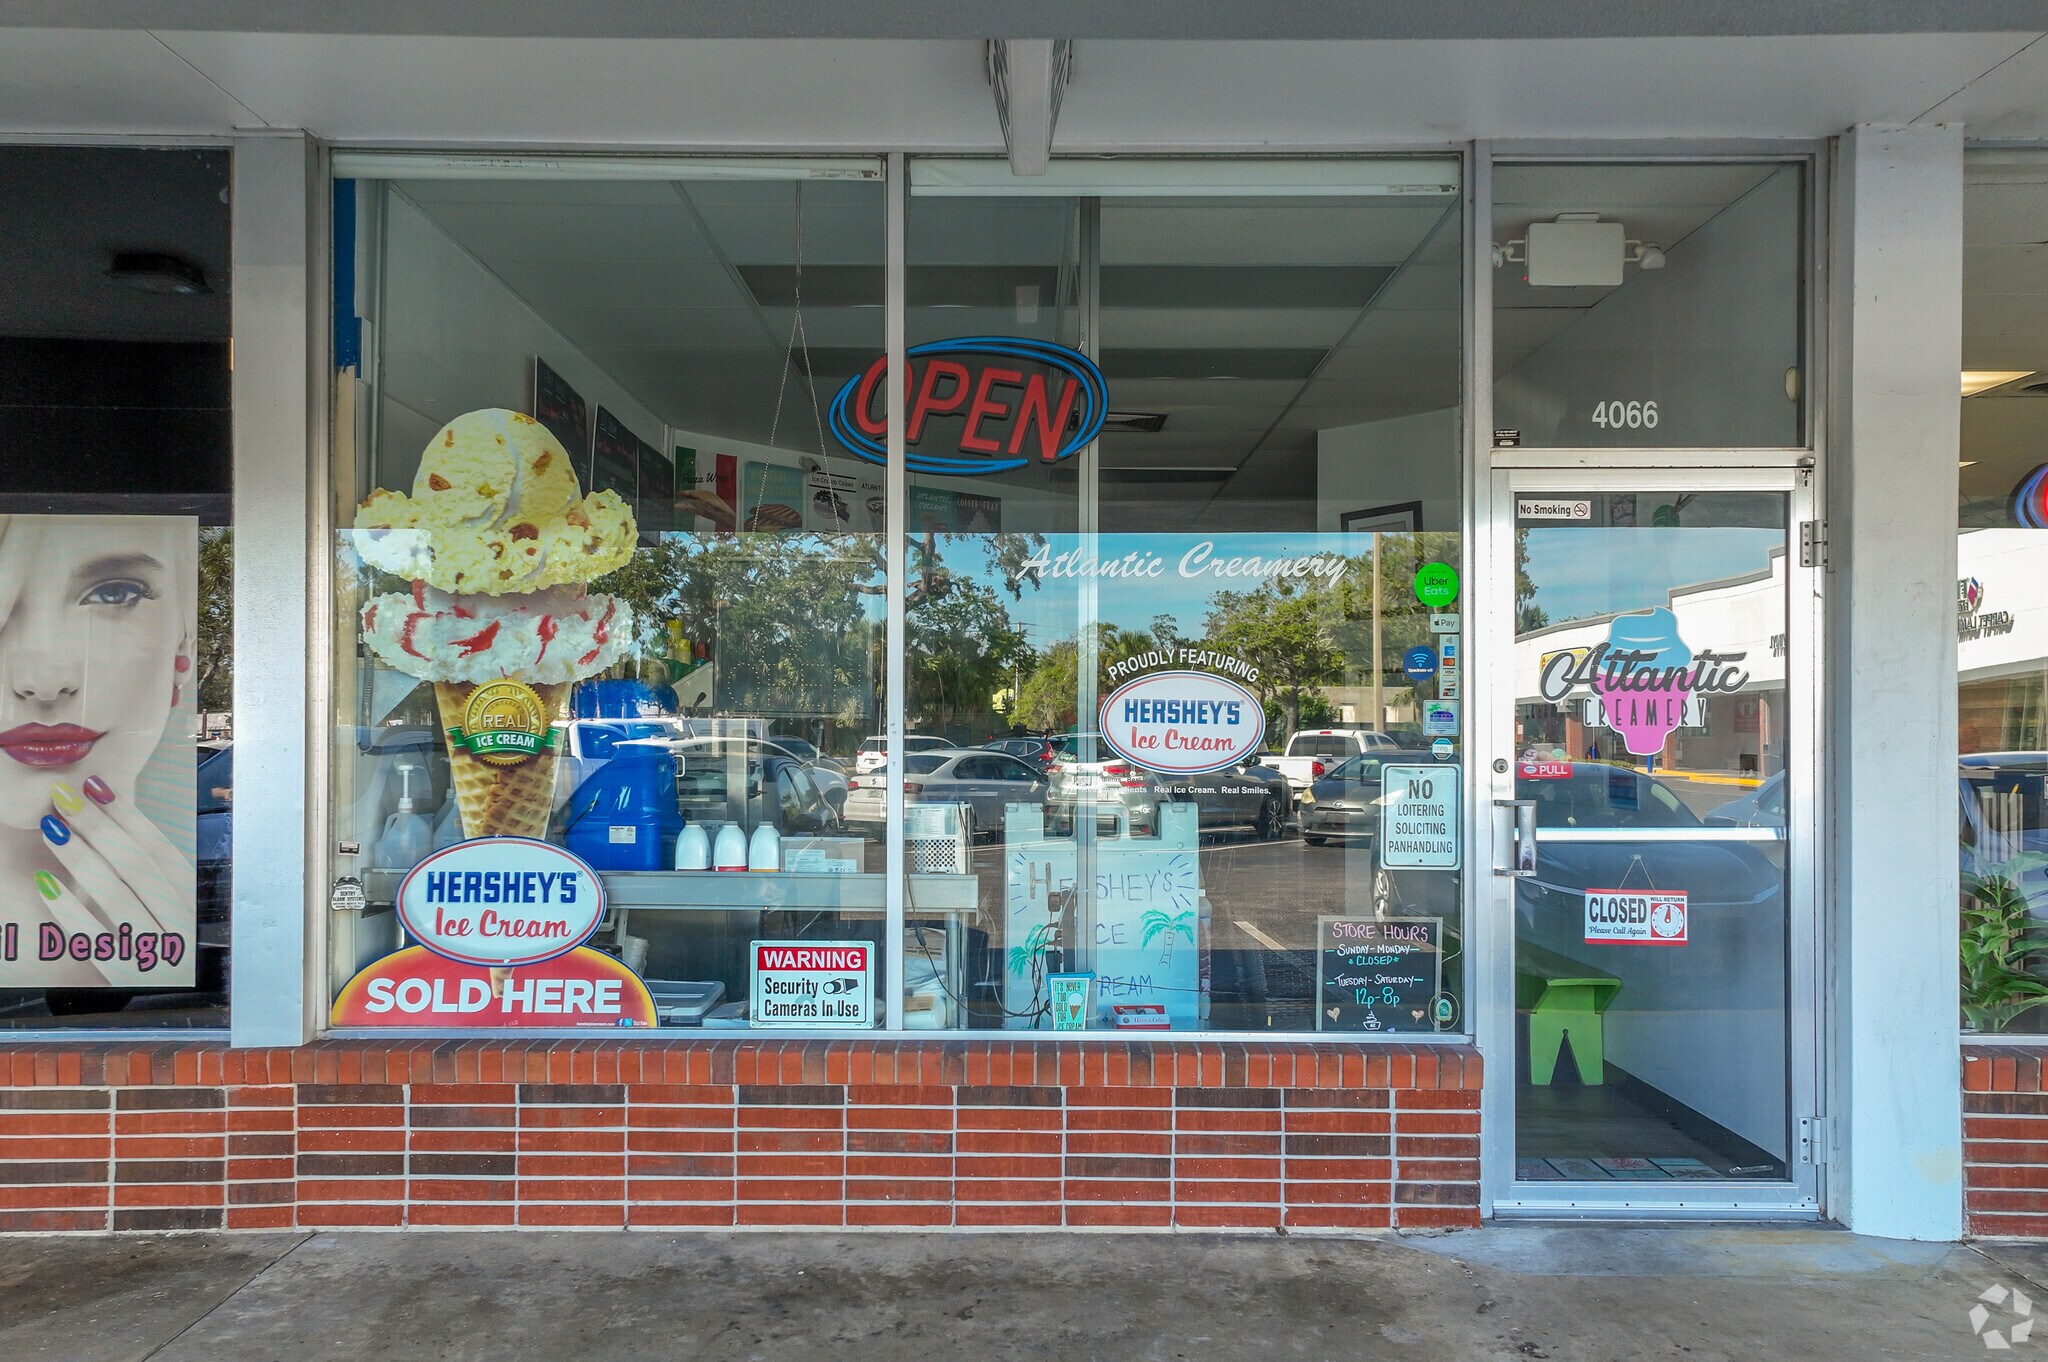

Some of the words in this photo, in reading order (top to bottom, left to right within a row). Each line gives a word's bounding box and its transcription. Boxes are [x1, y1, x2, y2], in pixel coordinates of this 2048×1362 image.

[855, 353, 1079, 460] OPEN
[1592, 400, 1659, 429] 4066
[811, 475, 820, 483] Ice
[838, 479, 855, 489] Cakes
[916, 493, 950, 504] ATLANTIC
[918, 502, 949, 512] CYCLONE
[957, 497, 978, 509] COFFEE
[983, 501, 999, 512] FRAP
[1520, 504, 1532, 515] No
[1534, 504, 1571, 517] Smoking
[1015, 543, 1165, 580] Atlantic
[1177, 541, 1350, 590] Creamery
[1424, 576, 1449, 586] Uber
[1424, 586, 1449, 596] Eats
[1441, 619, 1456, 628] Pay
[1108, 648, 1176, 682] PROUDLY
[1179, 648, 1260, 683] FEATURING
[1540, 642, 1750, 701] Atlantic
[1124, 698, 1241, 726] HERSHEY'S
[1584, 698, 1707, 727] CREAMERY
[483, 714, 527, 729] REAL
[476, 736, 494, 749] ICE
[497, 733, 536, 749] CREAM
[1131, 725, 1161, 750] Ice
[1164, 728, 1237, 751] Cream
[1539, 765, 1569, 775] PULL
[1154, 786, 1172, 794] Real
[1174, 786, 1186, 794] Ice
[1188, 786, 1217, 794] Cream.
[1221, 786, 1239, 794] Real
[1241, 786, 1272, 795] Smiles.
[1408, 779, 1434, 800] NO
[1397, 803, 1445, 817] LOITERING
[1395, 822, 1446, 835] SOLICITING
[1388, 841, 1453, 854] PANHANDLING
[427, 870, 577, 904] HERSHEY'S
[1588, 896, 1648, 924] CLOSED
[434, 907, 474, 937] Ice
[479, 908, 572, 938] Cream
[1332, 921, 1377, 939] STORE
[1383, 924, 1429, 942] HOURS
[1588, 925, 1612, 935] Please
[1612, 926, 1626, 935] Call
[1626, 927, 1647, 938] Again
[38, 921, 186, 973] Design
[763, 950, 862, 969] WARNING
[364, 978, 492, 1014] SOLD
[501, 978, 623, 1014] HERE
[764, 976, 819, 999] Security
[764, 999, 818, 1017] Cameras
[822, 999, 834, 1017] In
[837, 999, 860, 1017] Use
